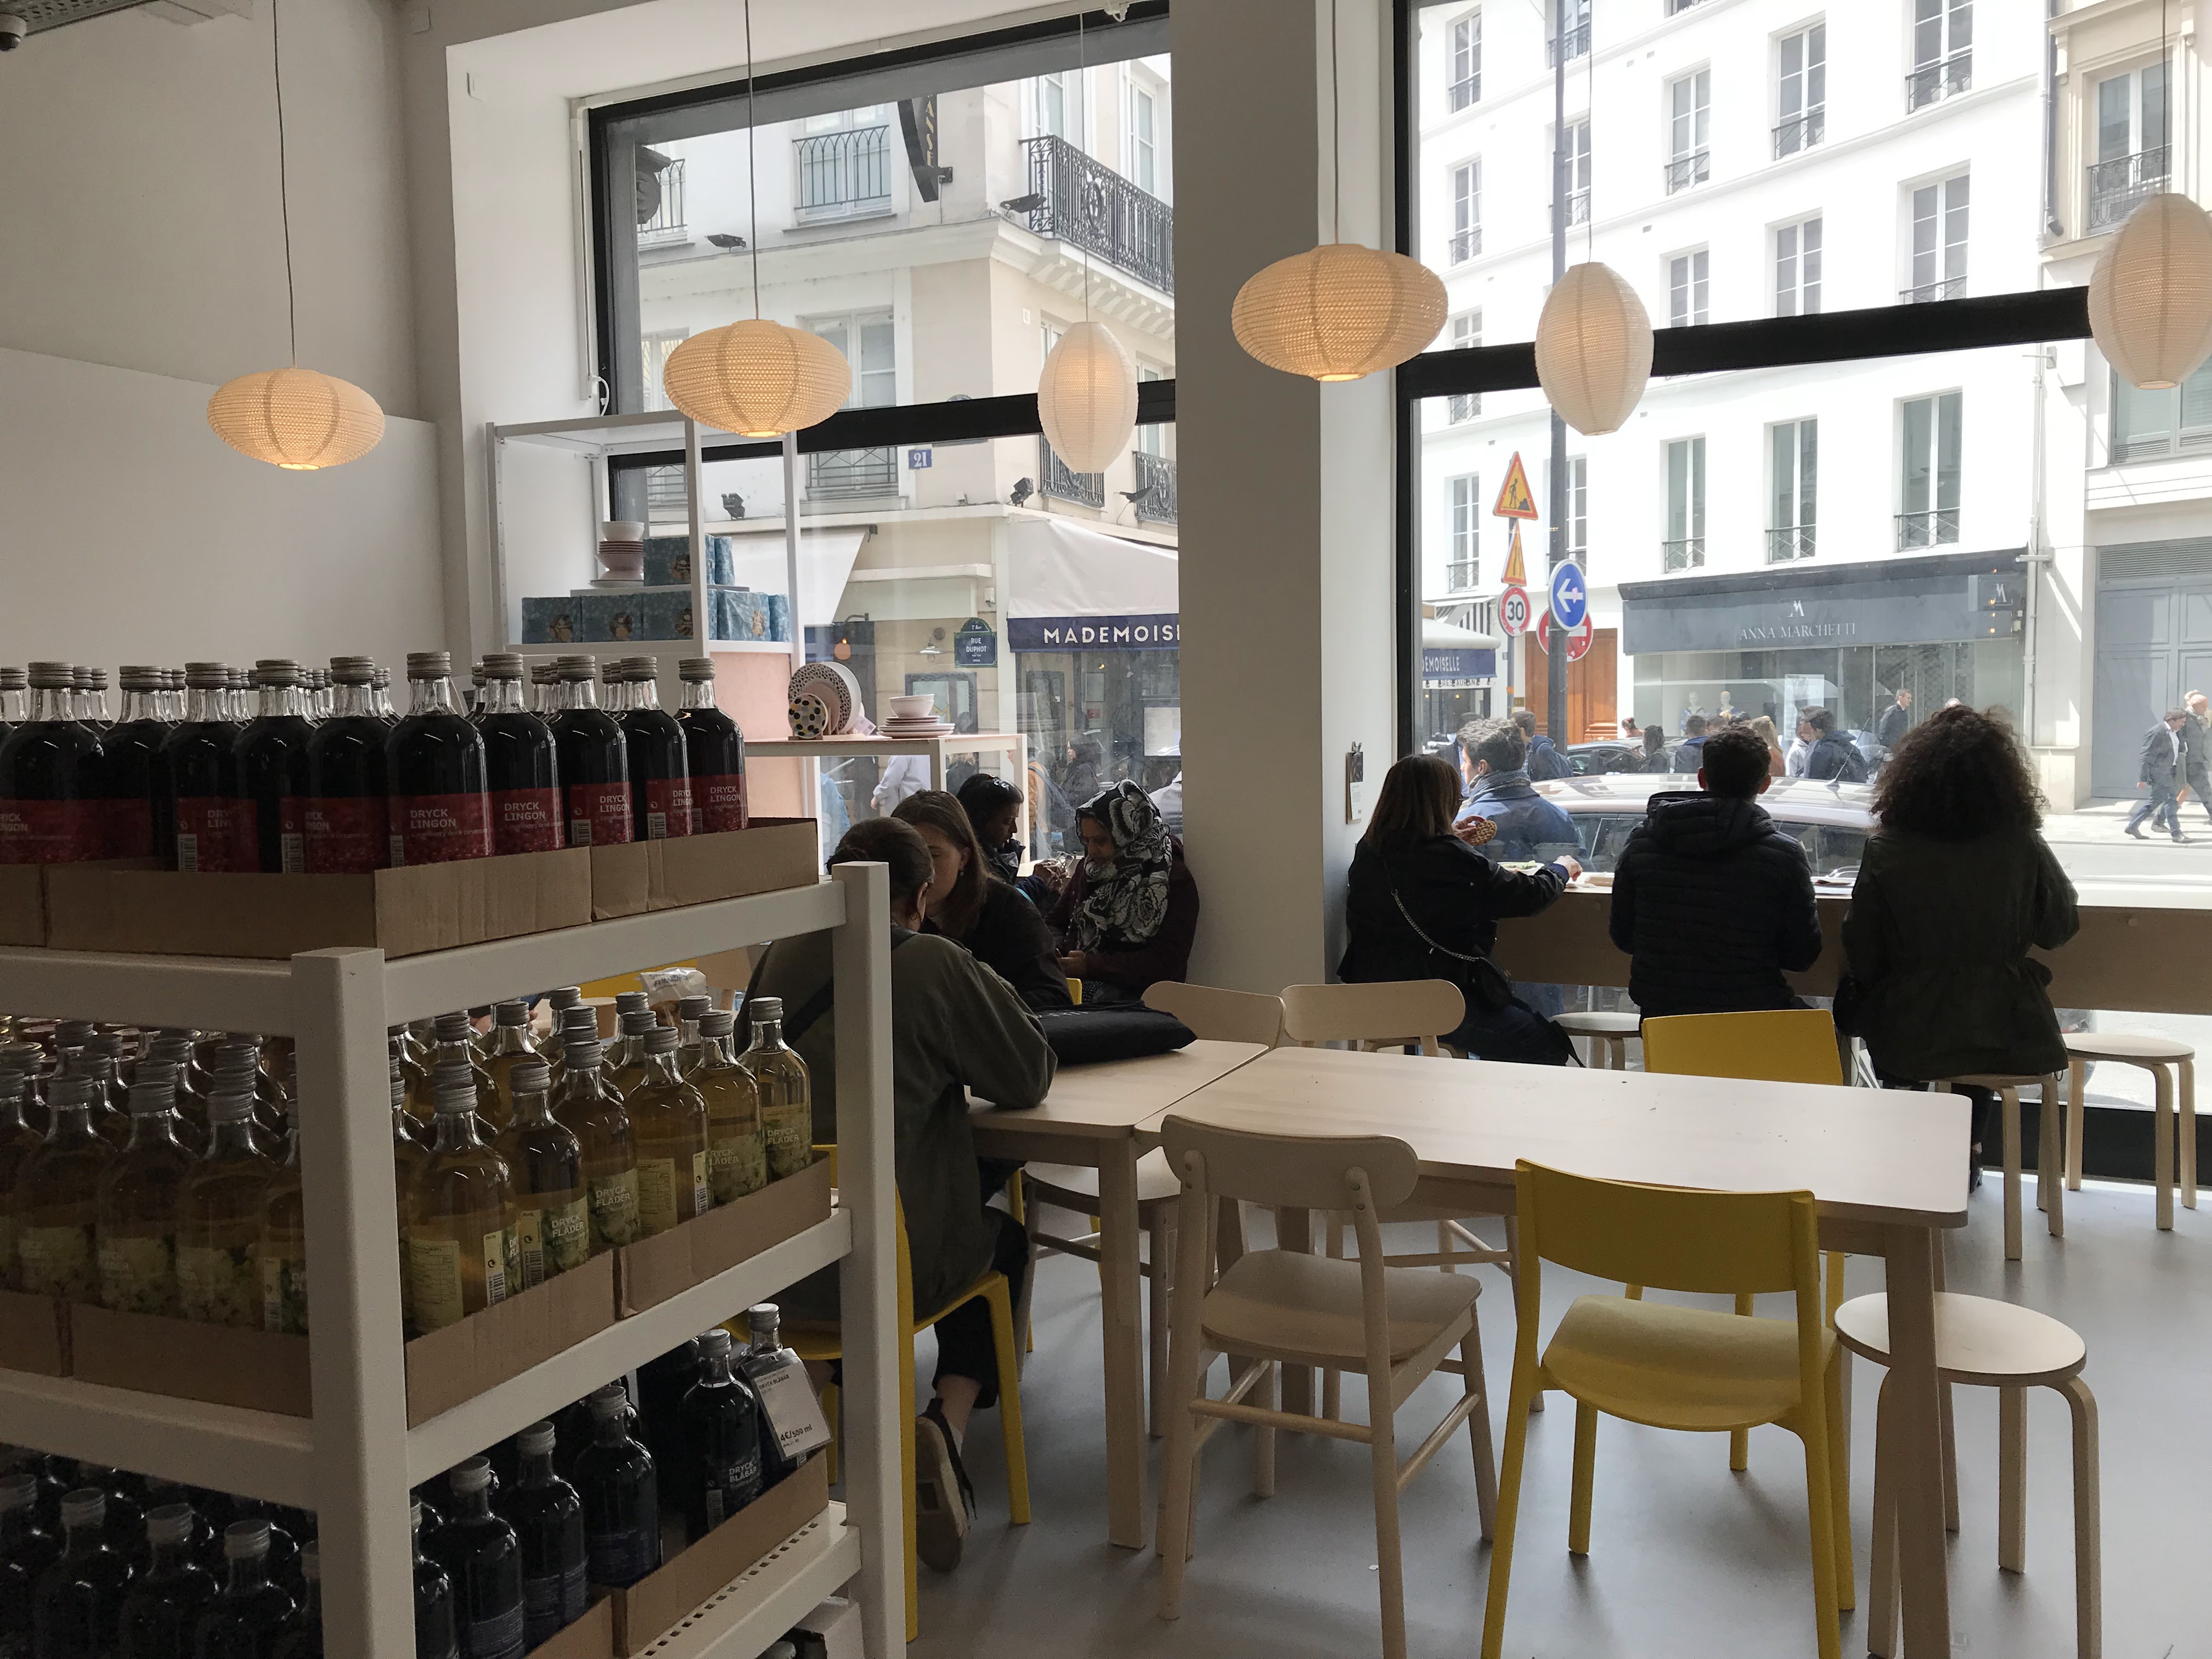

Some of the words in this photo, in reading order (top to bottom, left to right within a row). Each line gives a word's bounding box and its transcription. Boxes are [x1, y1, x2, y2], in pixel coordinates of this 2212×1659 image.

[914, 452, 928, 467] 21
[1507, 601, 1524, 621] 30
[1740, 627, 1775, 640] ANNA
[1781, 623, 1855, 639] MARCHETTI
[710, 786, 737, 794] DRYCK
[504, 802, 540, 811] DRYCK
[410, 809, 449, 819] DRYCK
[505, 811, 546, 821] LINGON
[411, 818, 457, 829] LINGON
[768, 1127, 796, 1137] DRYCK
[804, 1424, 813, 1432] ml
[729, 1460, 754, 1475] DRYCK
